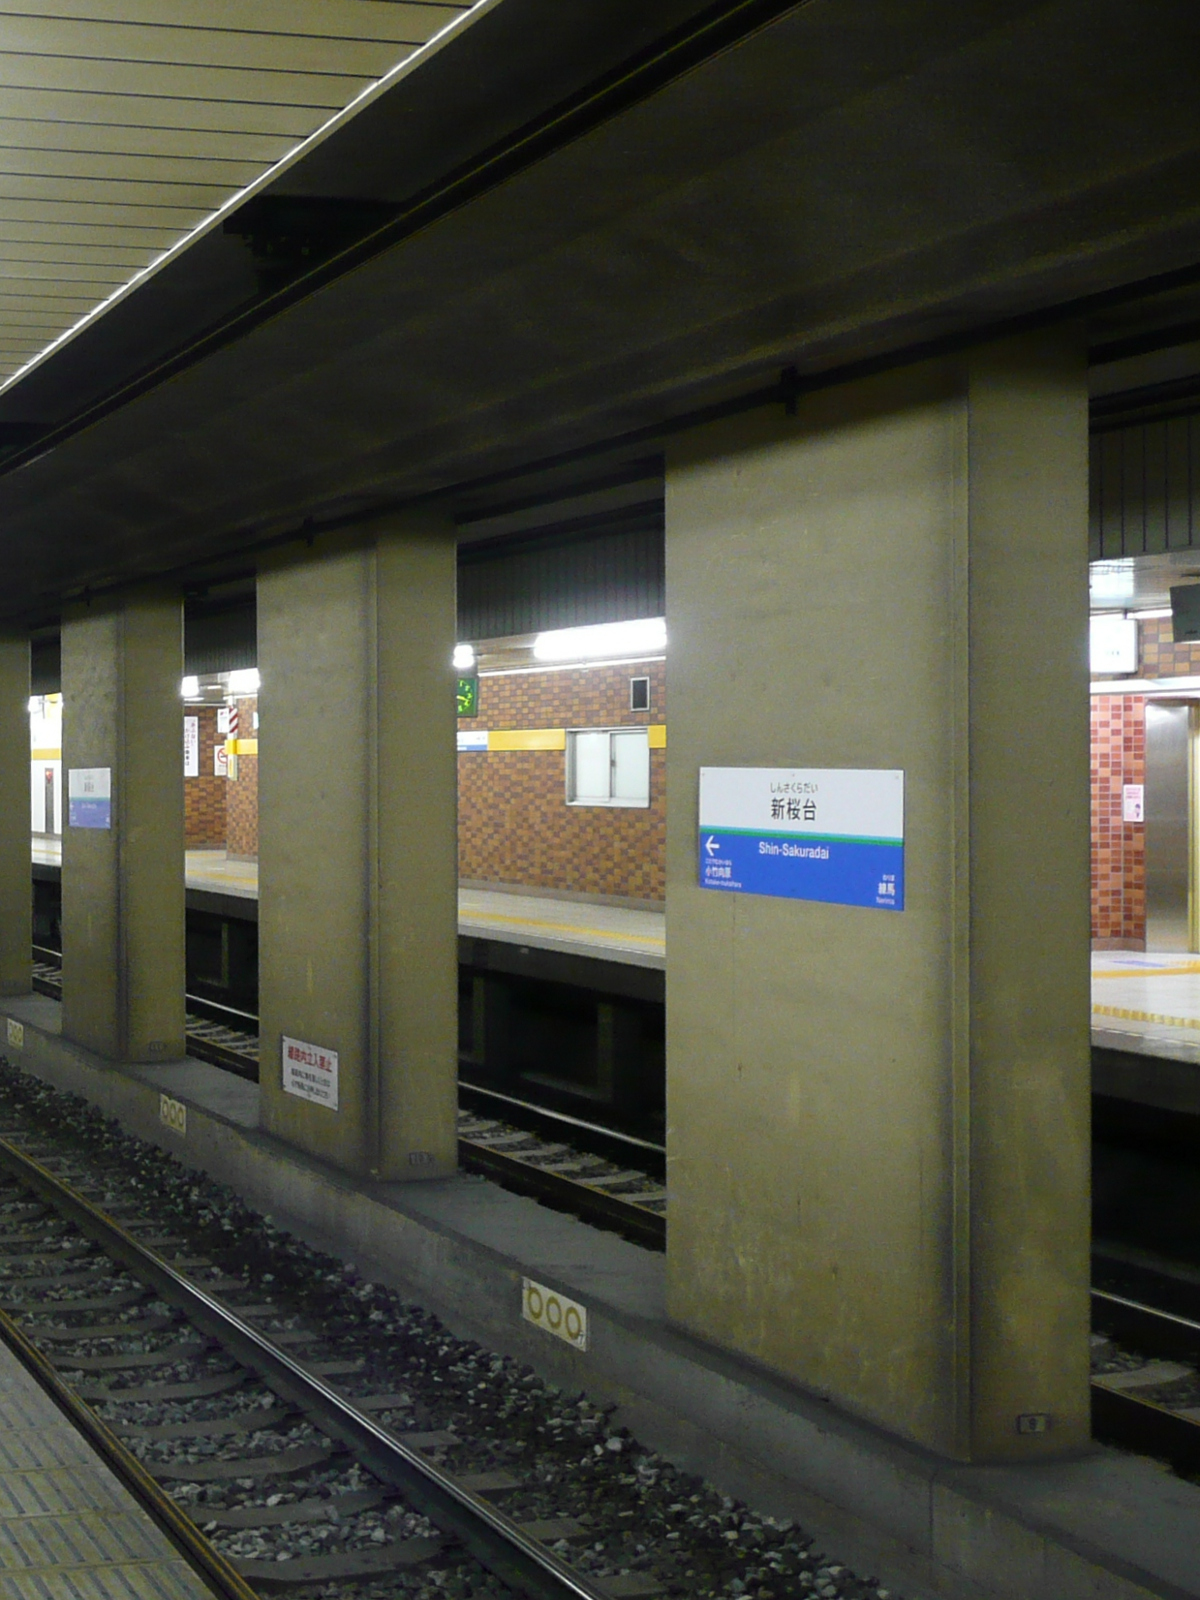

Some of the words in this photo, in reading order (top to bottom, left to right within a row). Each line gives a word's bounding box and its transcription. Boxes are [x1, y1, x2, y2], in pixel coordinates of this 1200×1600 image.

[770, 782, 819, 794] しんさくらだい
[771, 798, 817, 821] 新桜台
[758, 842, 829, 860] Shin-Sakuradai
